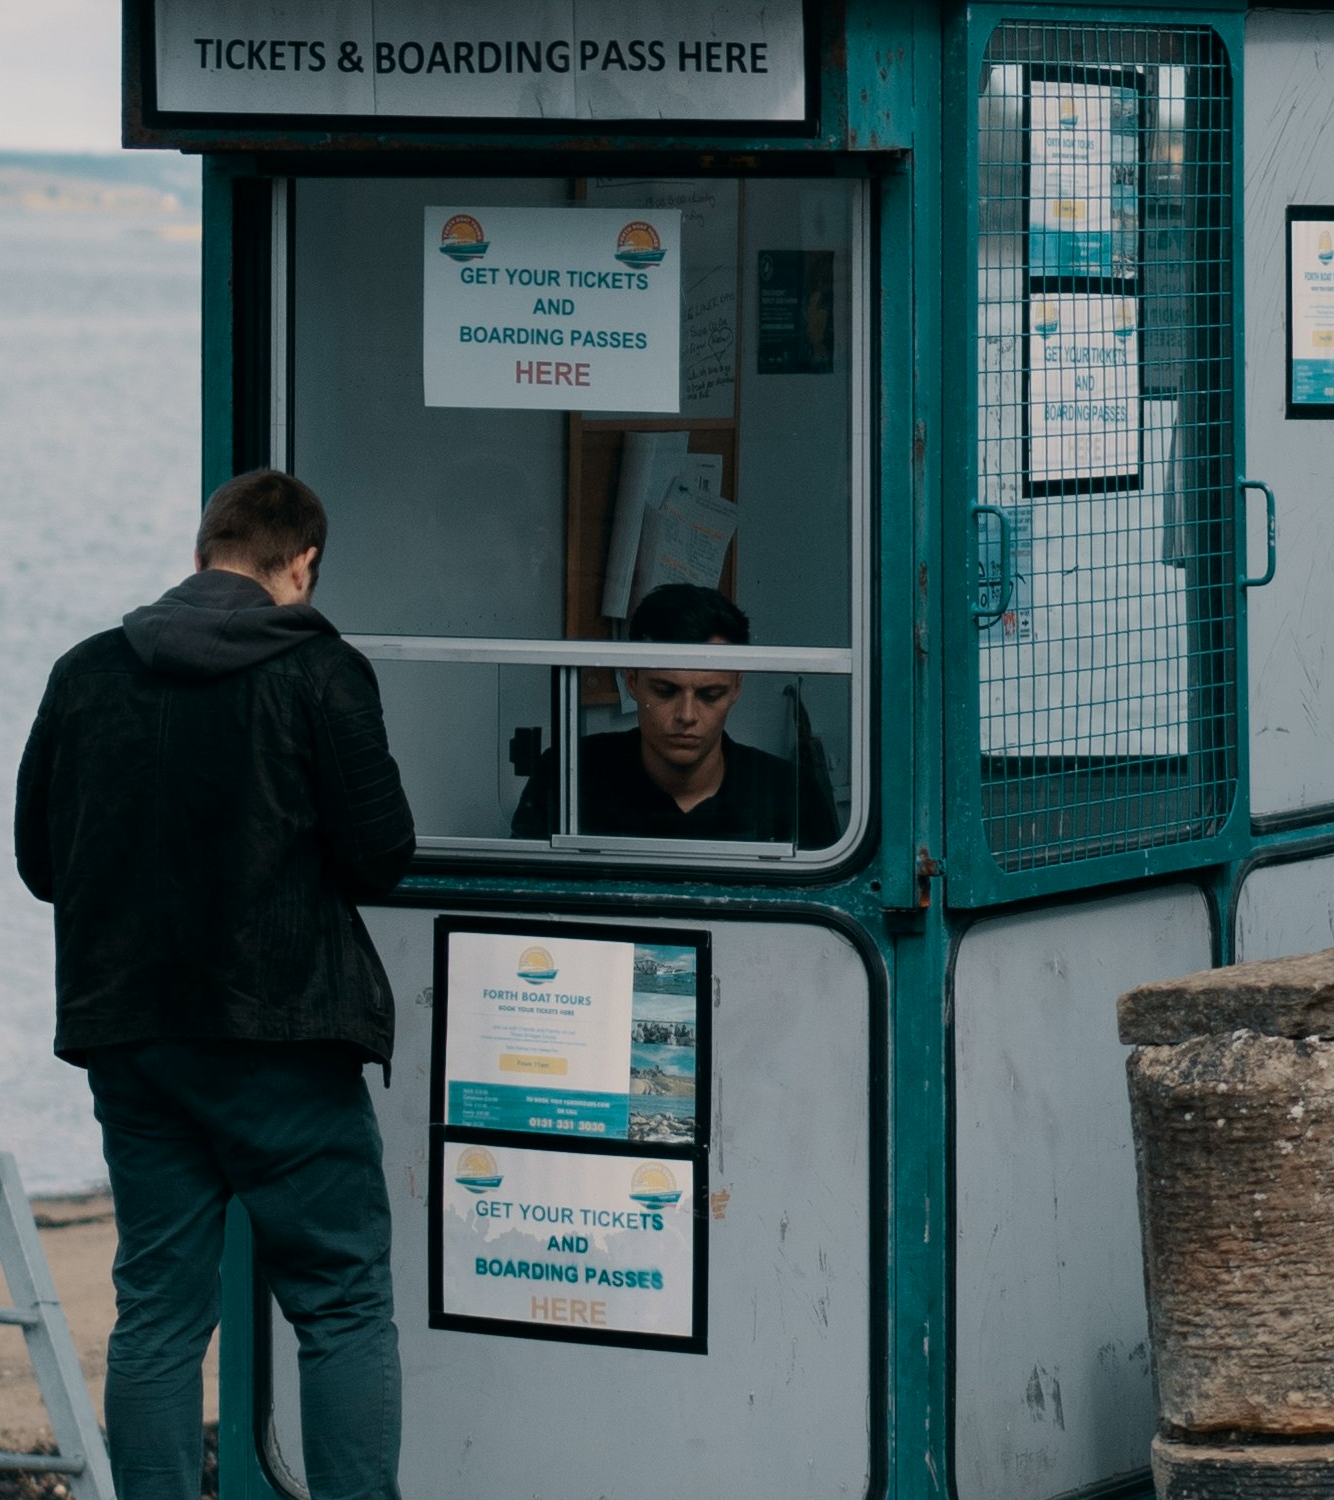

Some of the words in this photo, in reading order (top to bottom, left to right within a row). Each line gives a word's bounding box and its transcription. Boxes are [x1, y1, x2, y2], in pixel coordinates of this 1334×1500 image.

[194, 38, 326, 72] TICKETS
[337, 40, 365, 73] &
[376, 40, 571, 74] BOARDING
[580, 39, 666, 72] PASS
[678, 40, 769, 74] HERE
[461, 267, 499, 284] GET
[505, 268, 561, 286] YOUR
[566, 270, 649, 290] TICKETS
[533, 299, 575, 316] AND
[460, 326, 564, 346] BOARDING
[570, 330, 647, 349] PASSES
[516, 360, 591, 387] HERE
[1075, 375, 1095, 391] AND
[483, 989, 519, 1001] FORTH
[522, 991, 552, 1003] BOAT
[555, 993, 592, 1006] TOURS
[475, 1200, 513, 1219] GET
[519, 1203, 574, 1225] YOUR
[580, 1208, 664, 1231] TICKETS
[547, 1235, 589, 1254] AND
[475, 1257, 579, 1283] BOARDING
[585, 1267, 664, 1290] PASSES
[530, 1295, 607, 1325] HERE
